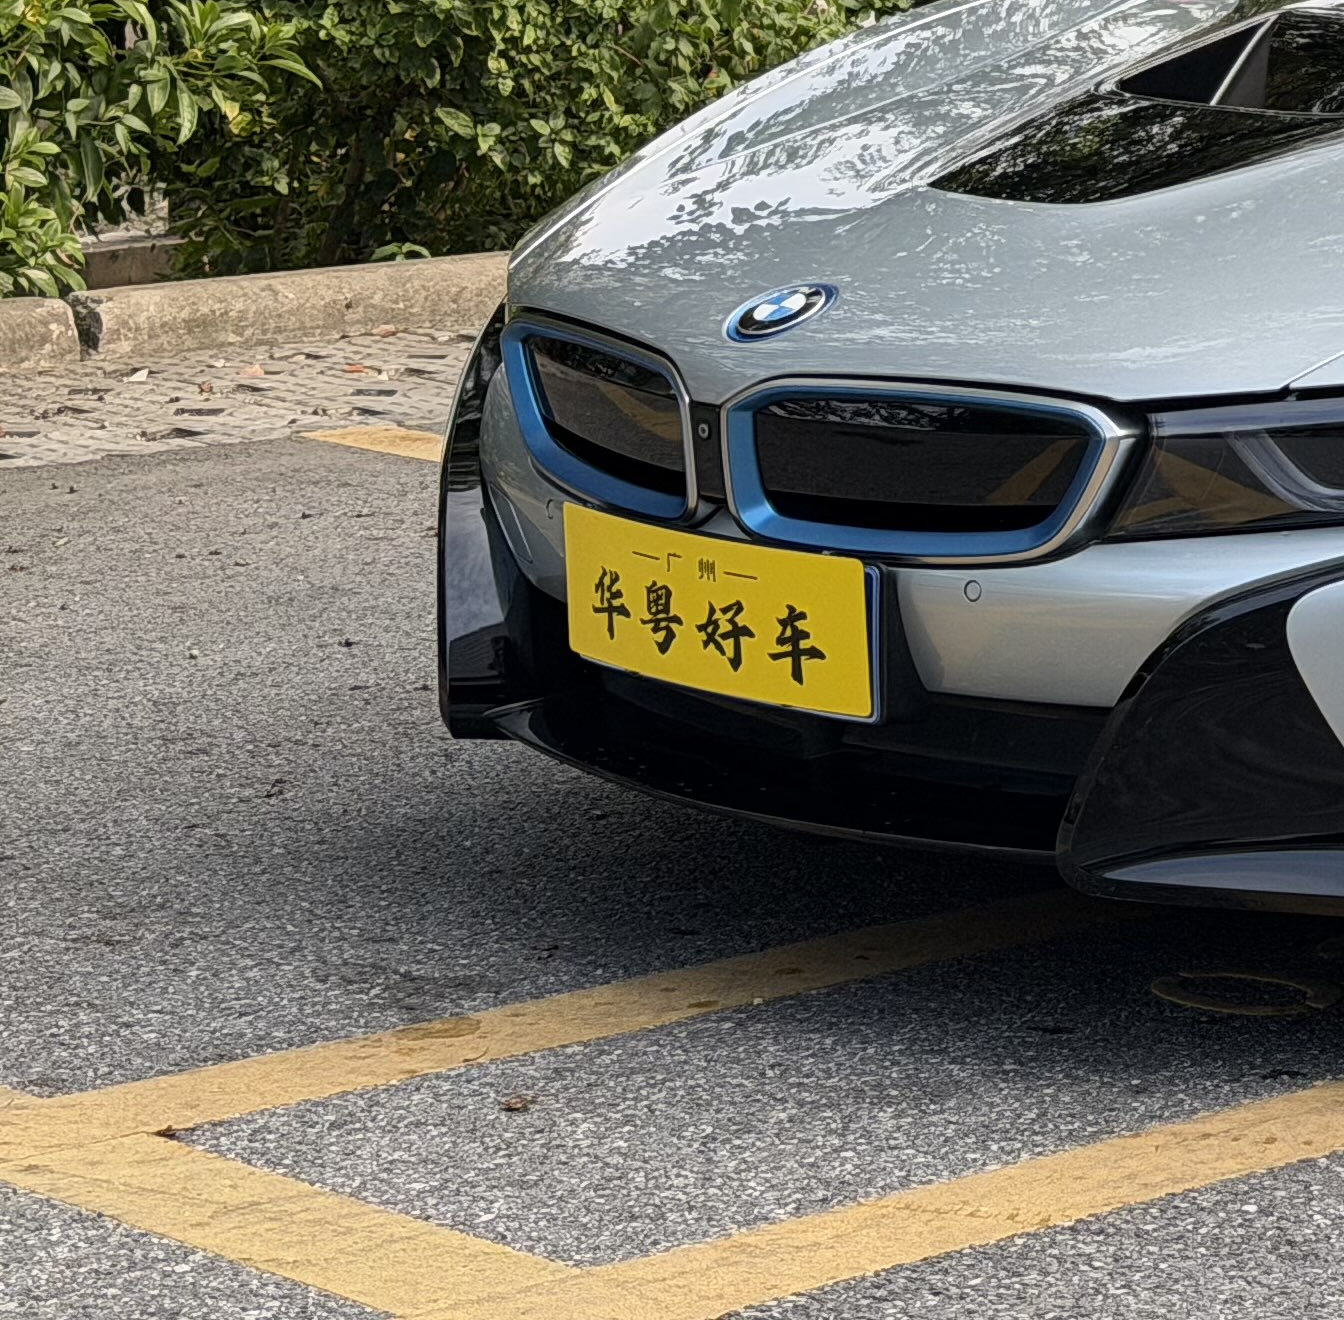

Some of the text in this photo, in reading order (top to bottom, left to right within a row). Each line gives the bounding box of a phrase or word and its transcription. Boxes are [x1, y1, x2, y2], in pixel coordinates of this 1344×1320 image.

[667, 552, 717, 582] 广州
[591, 566, 827, 686] 华粤好车
